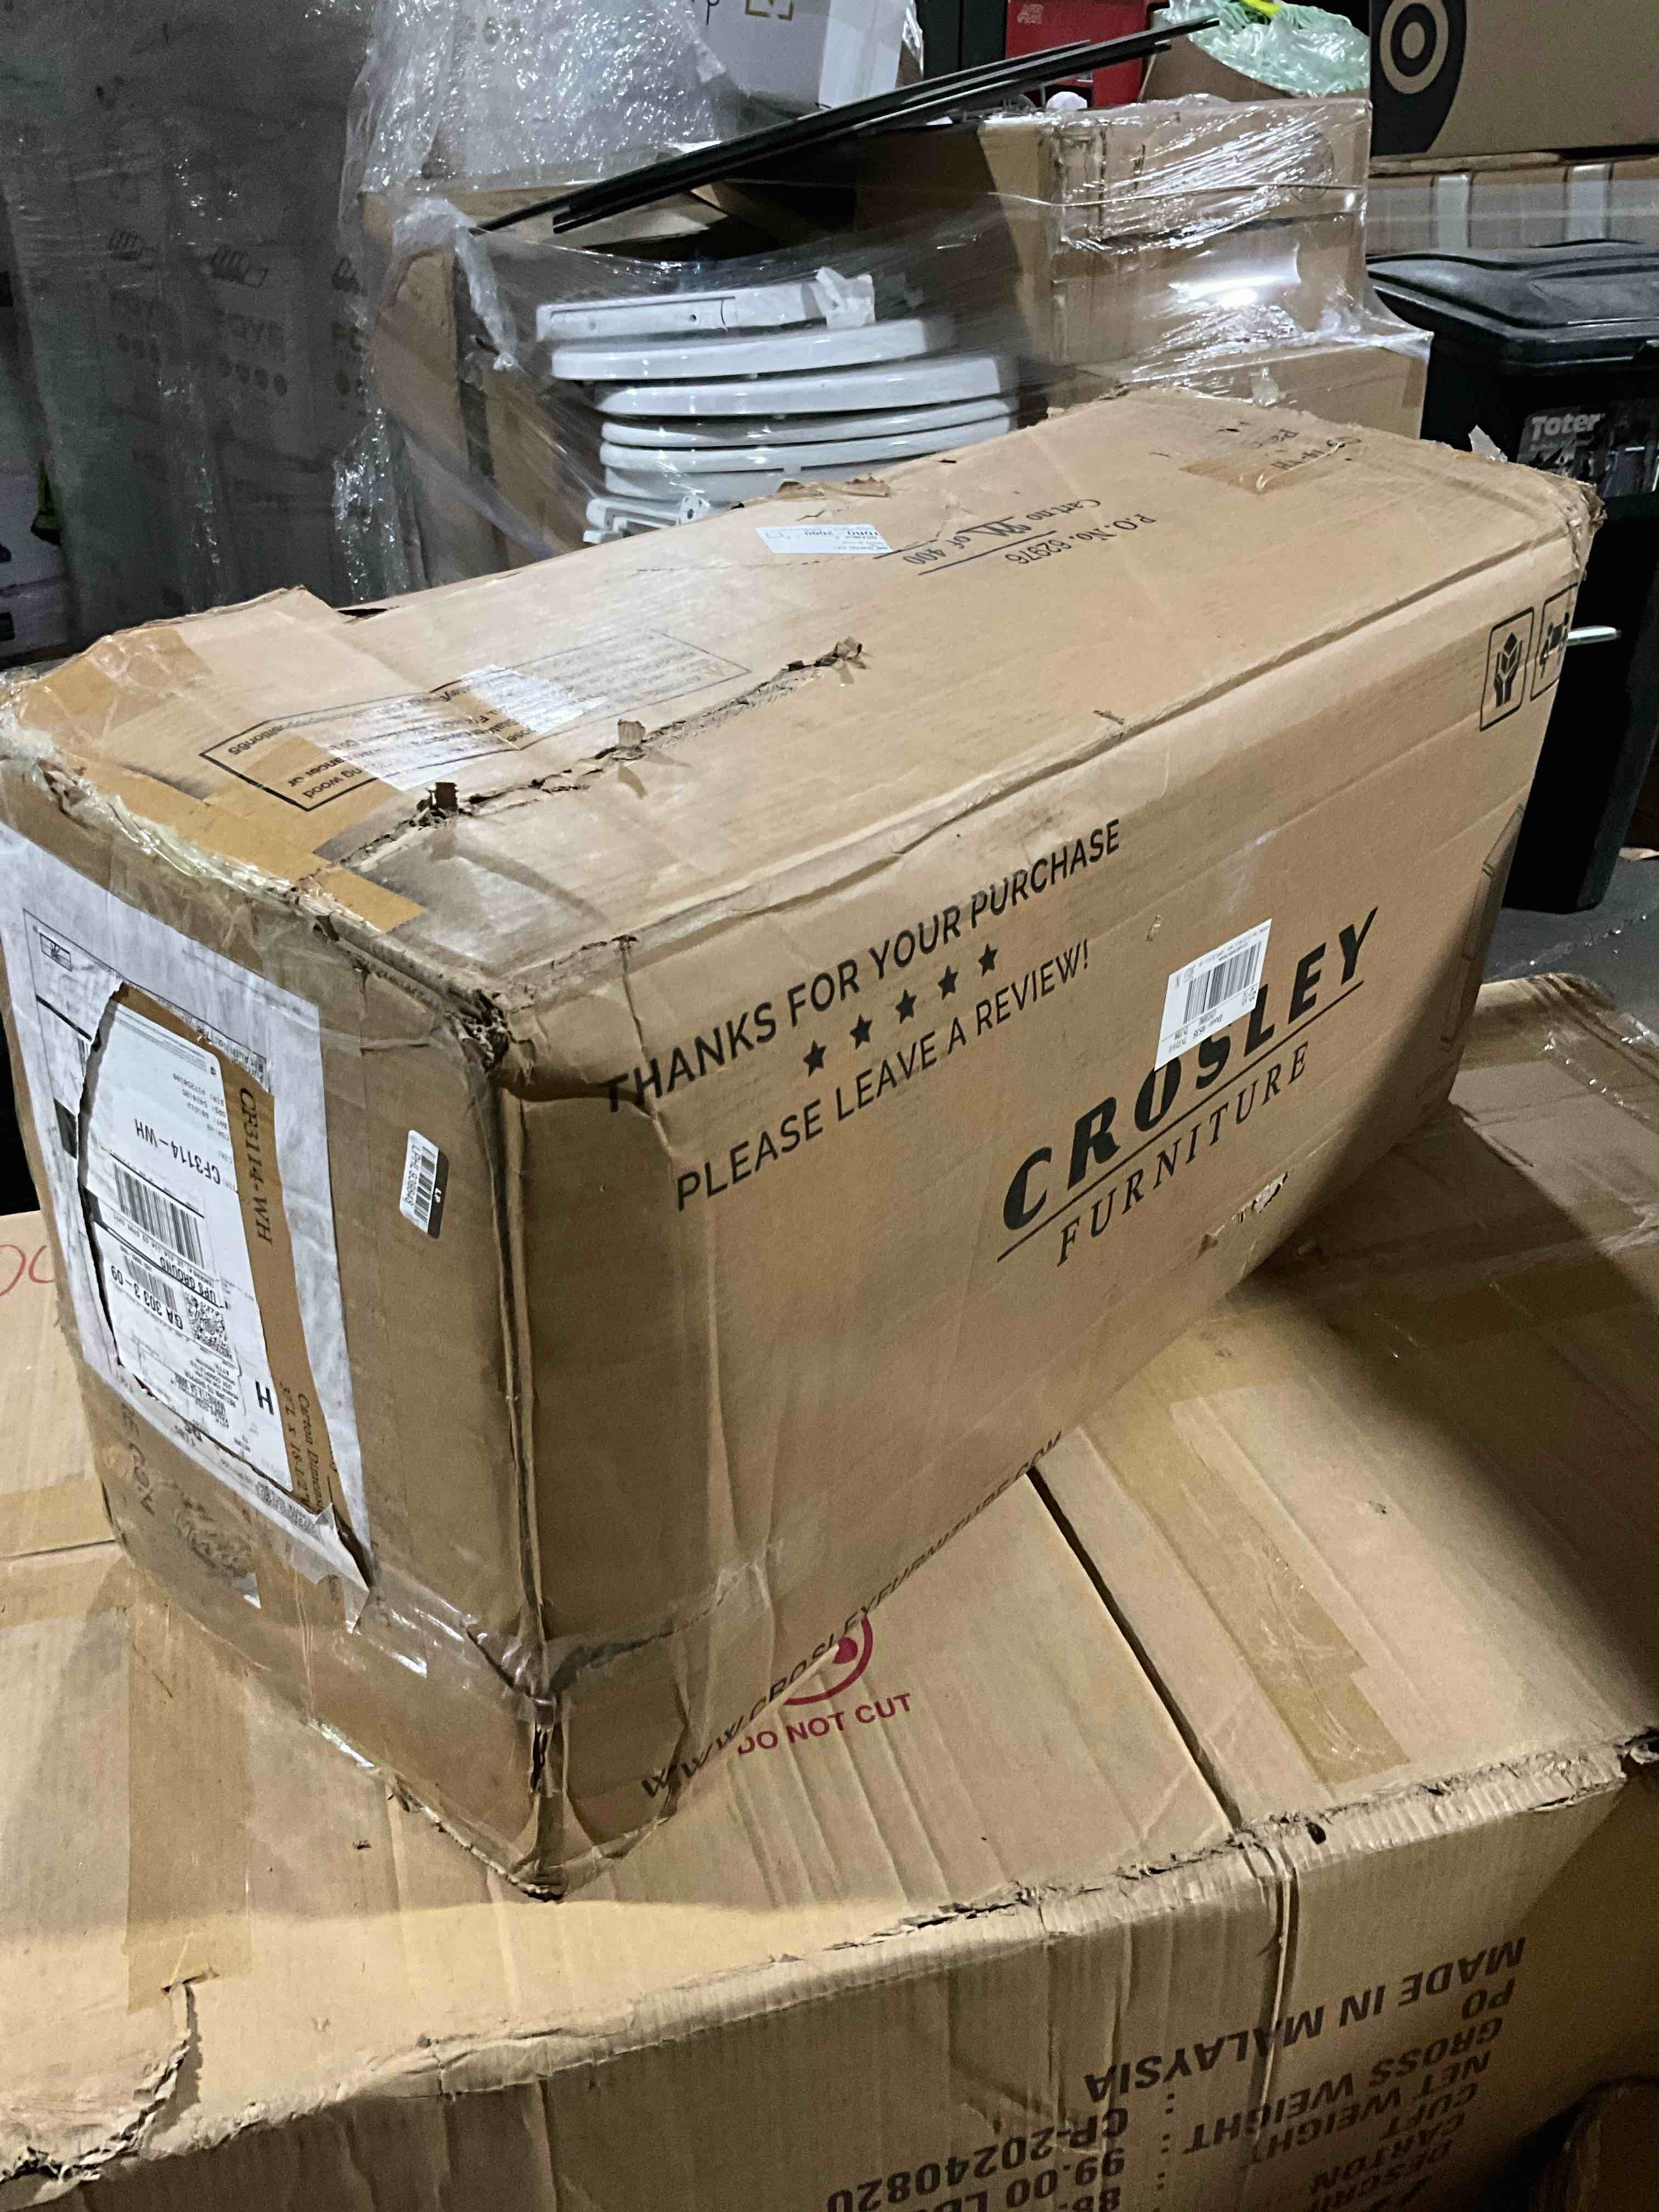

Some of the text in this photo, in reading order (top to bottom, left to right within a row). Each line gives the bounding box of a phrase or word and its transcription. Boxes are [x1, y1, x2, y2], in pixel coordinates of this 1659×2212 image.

[1531, 413, 1601, 441] Toter
[903, 547, 946, 566] 400
[1004, 537, 1071, 565] 62976
[303, 774, 341, 799] wood
[606, 818, 1121, 1113] THANKS FOR YOUR PURCHASE
[676, 1099, 825, 1212] PLEASE
[836, 1031, 937, 1122] LEAVE
[947, 1016, 967, 1055] A
[975, 938, 1090, 1036] REVIEW!
[1002, 906, 1379, 1231] CROSLEY
[134, 1119, 221, 1185] CF3114-WH
[240, 1088, 272, 1247] CF3114-WH
[1057, 1041, 1309, 1268] FURNITURE
[435, 1188, 442, 1203] LP
[160, 1256, 196, 1293] GROUND
[198, 1282, 217, 1305] UPS
[167, 1308, 183, 1330] GA
[255, 1380, 274, 1415] H
[787, 1711, 845, 1745] NOT
[855, 1693, 911, 1724] CUT
[1084, 1937, 1527, 2103] MADE IN MALAYSIA
[1462, 1976, 1516, 2021] PO
[1368, 2017, 1503, 2087] GROSS
[1413, 2049, 1491, 2101] NET
[1184, 2072, 1353, 2154] WEIGHT
[1239, 2086, 1401, 2168] WEIGHT
[1379, 2083, 1479, 2141] CUFT
[1006, 2147, 1125, 2208] 99.00
[1311, 2112, 1466, 2195] CARTON
